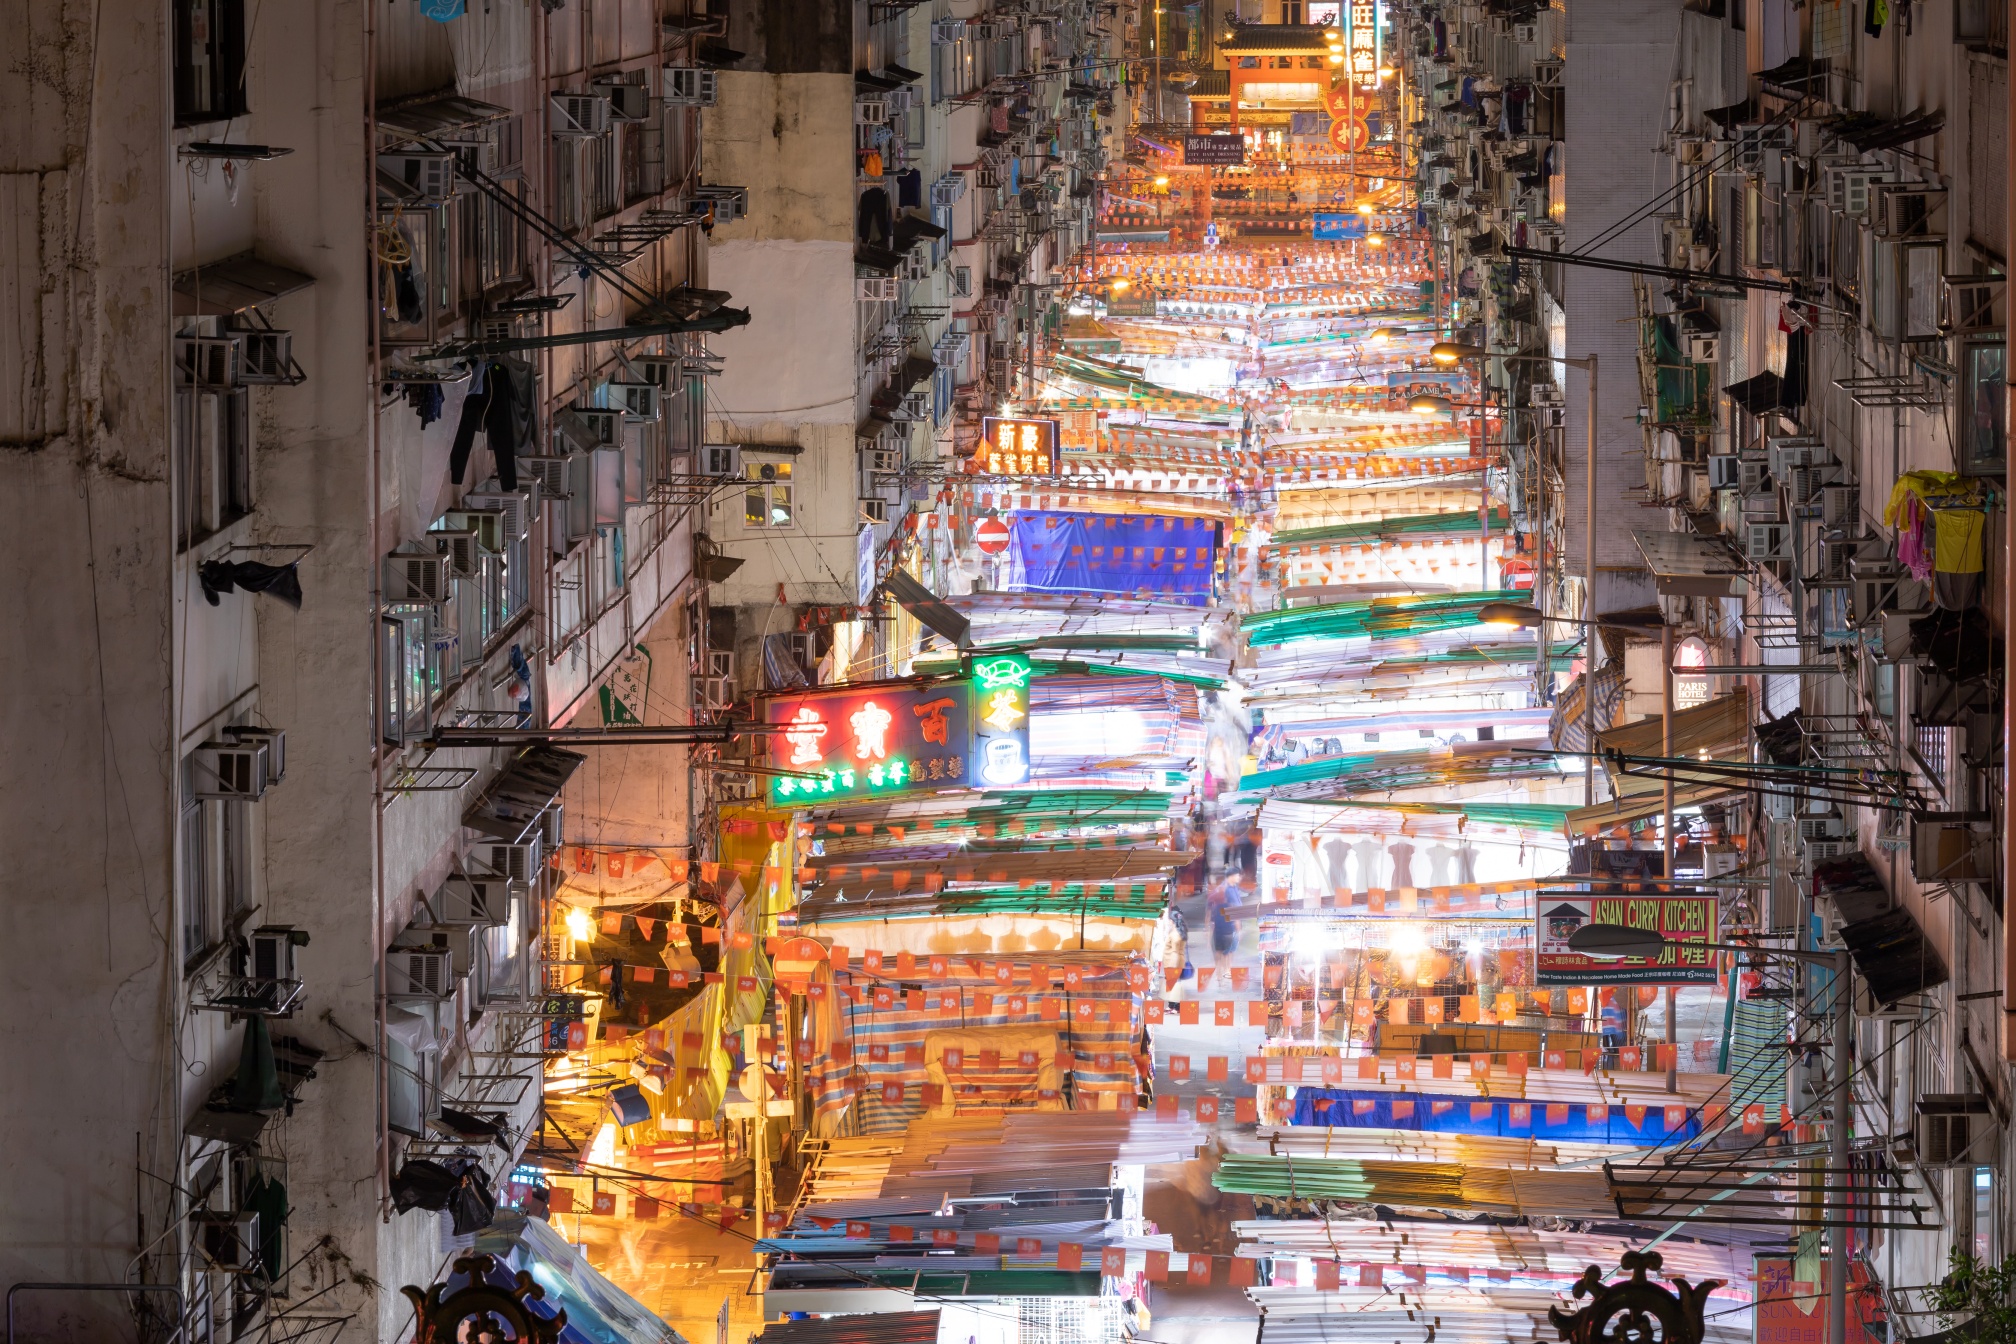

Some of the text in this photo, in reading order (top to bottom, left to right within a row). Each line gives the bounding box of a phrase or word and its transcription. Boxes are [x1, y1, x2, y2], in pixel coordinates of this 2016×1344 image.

[1337, 121, 1362, 147] 押
[1188, 138, 1212, 150] 都市
[999, 423, 1038, 451] 新豪
[1678, 682, 1707, 691] PARIS
[1678, 690, 1707, 698] HOTEL
[1595, 900, 1705, 932] ASIAN CURRY KITCHEN
[1760, 1305, 1792, 1319] SUN
